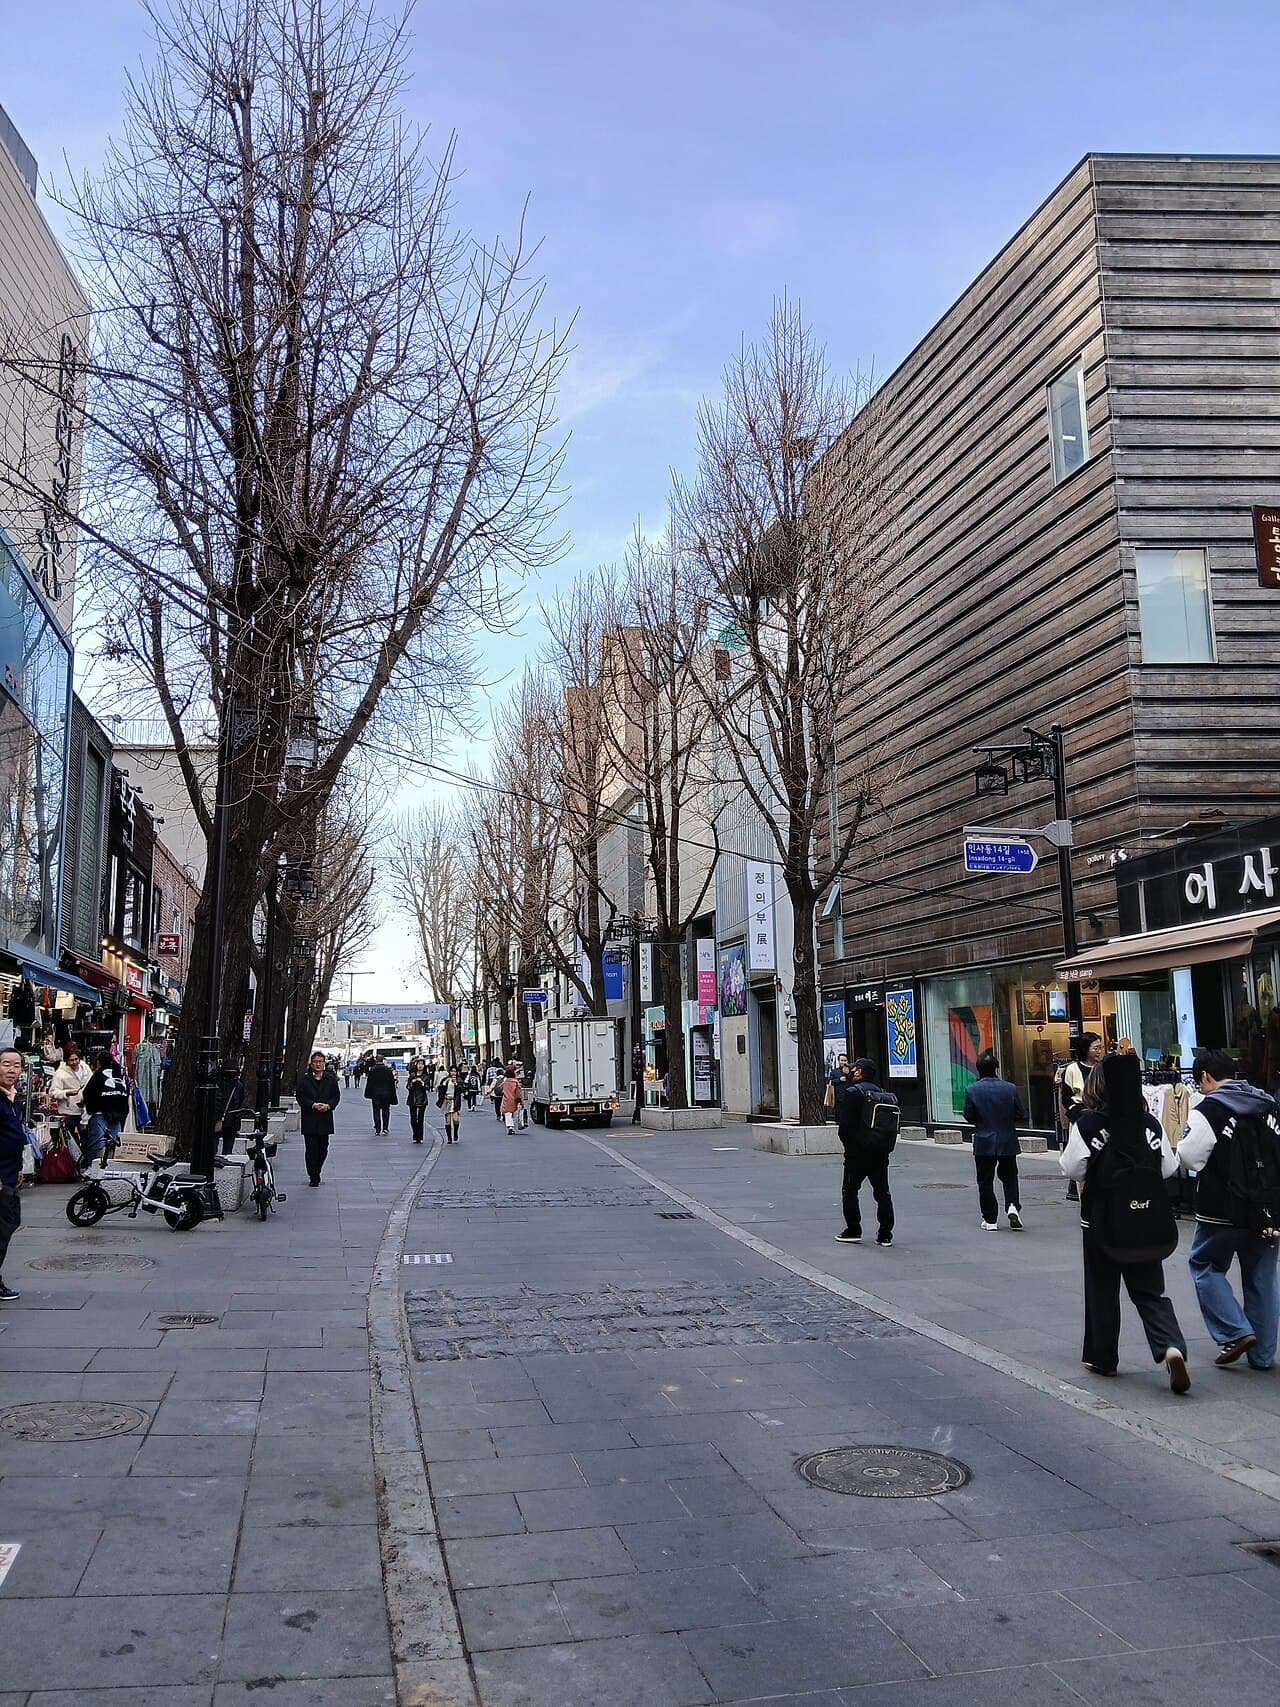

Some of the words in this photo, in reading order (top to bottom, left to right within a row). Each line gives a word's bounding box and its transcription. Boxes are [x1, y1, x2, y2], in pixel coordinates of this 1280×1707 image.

[967, 844, 1010, 855] 인사동14길
[968, 855, 996, 863] Insadong
[998, 856, 1016, 864] 14-gil
